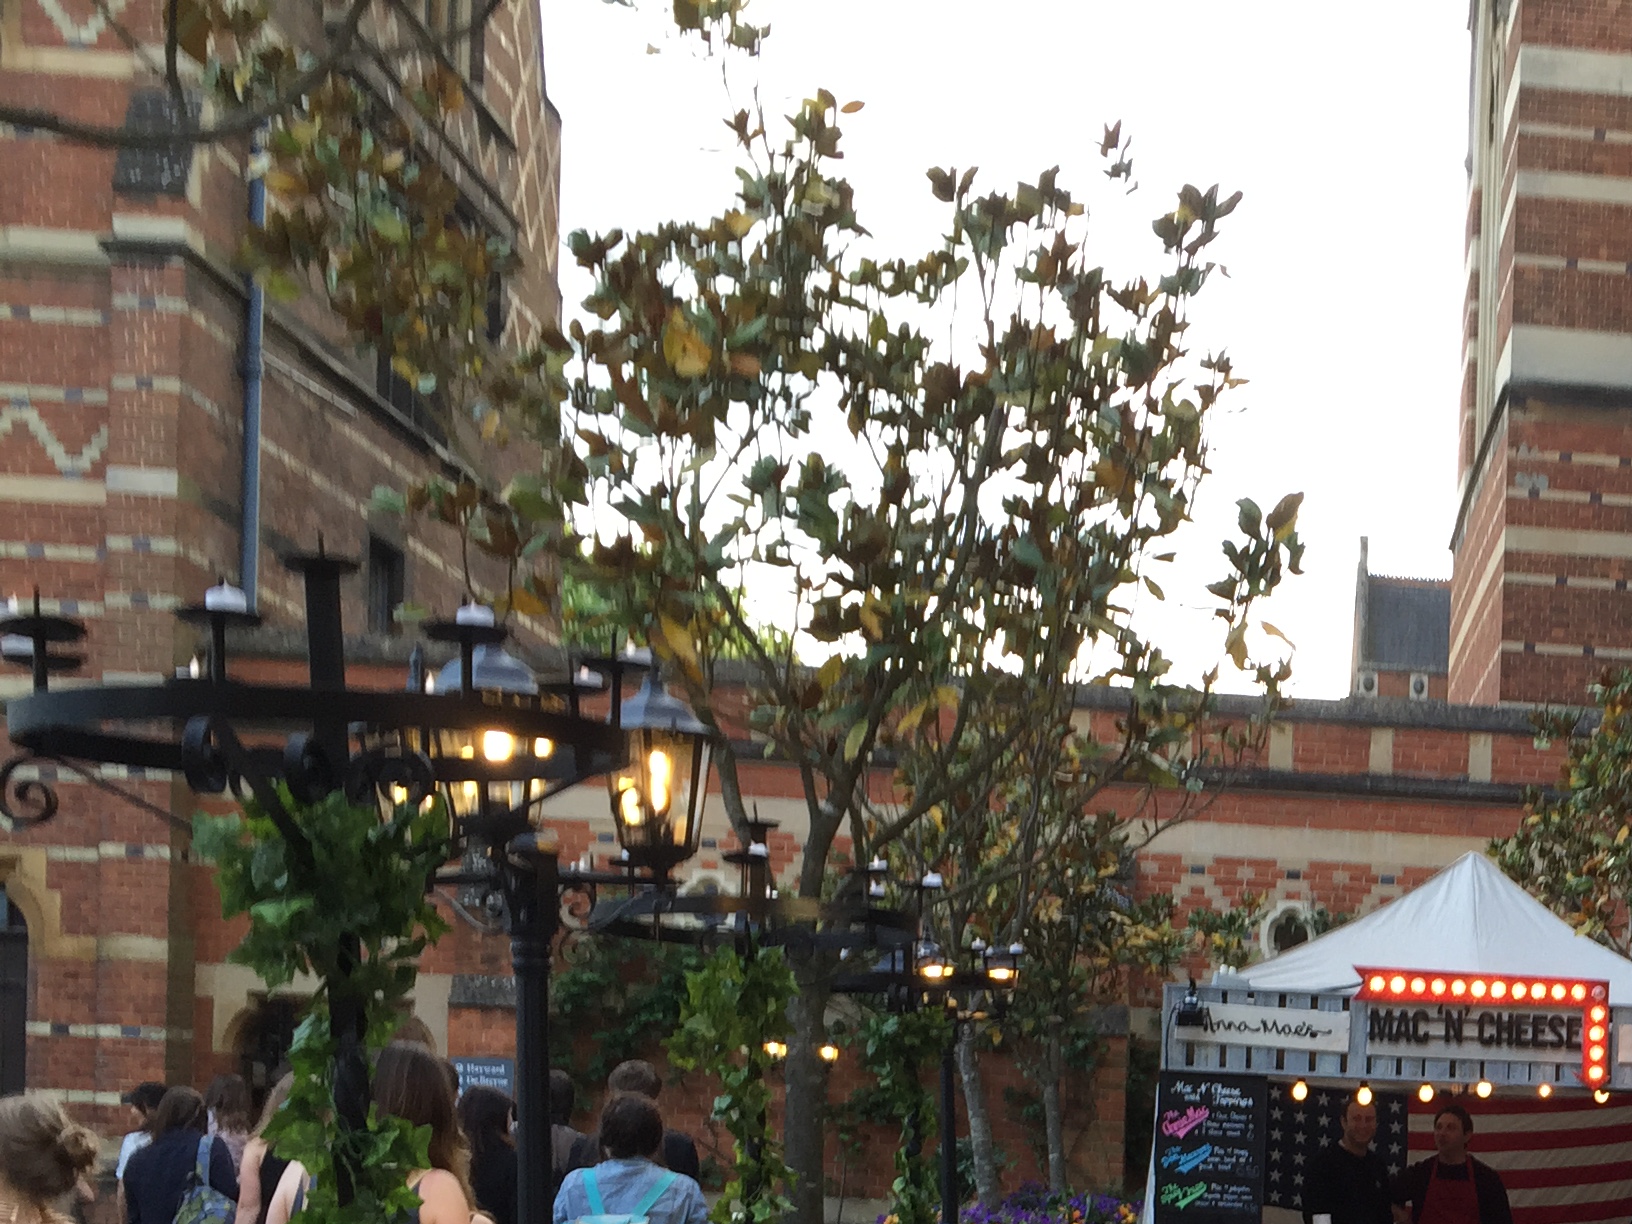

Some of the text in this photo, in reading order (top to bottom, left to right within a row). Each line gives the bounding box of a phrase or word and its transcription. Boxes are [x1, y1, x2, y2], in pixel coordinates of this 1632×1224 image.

[1203, 1006, 1257, 1034] Anna
[1369, 1007, 1430, 1043] MAC
[1477, 1010, 1583, 1050] CHEESE
